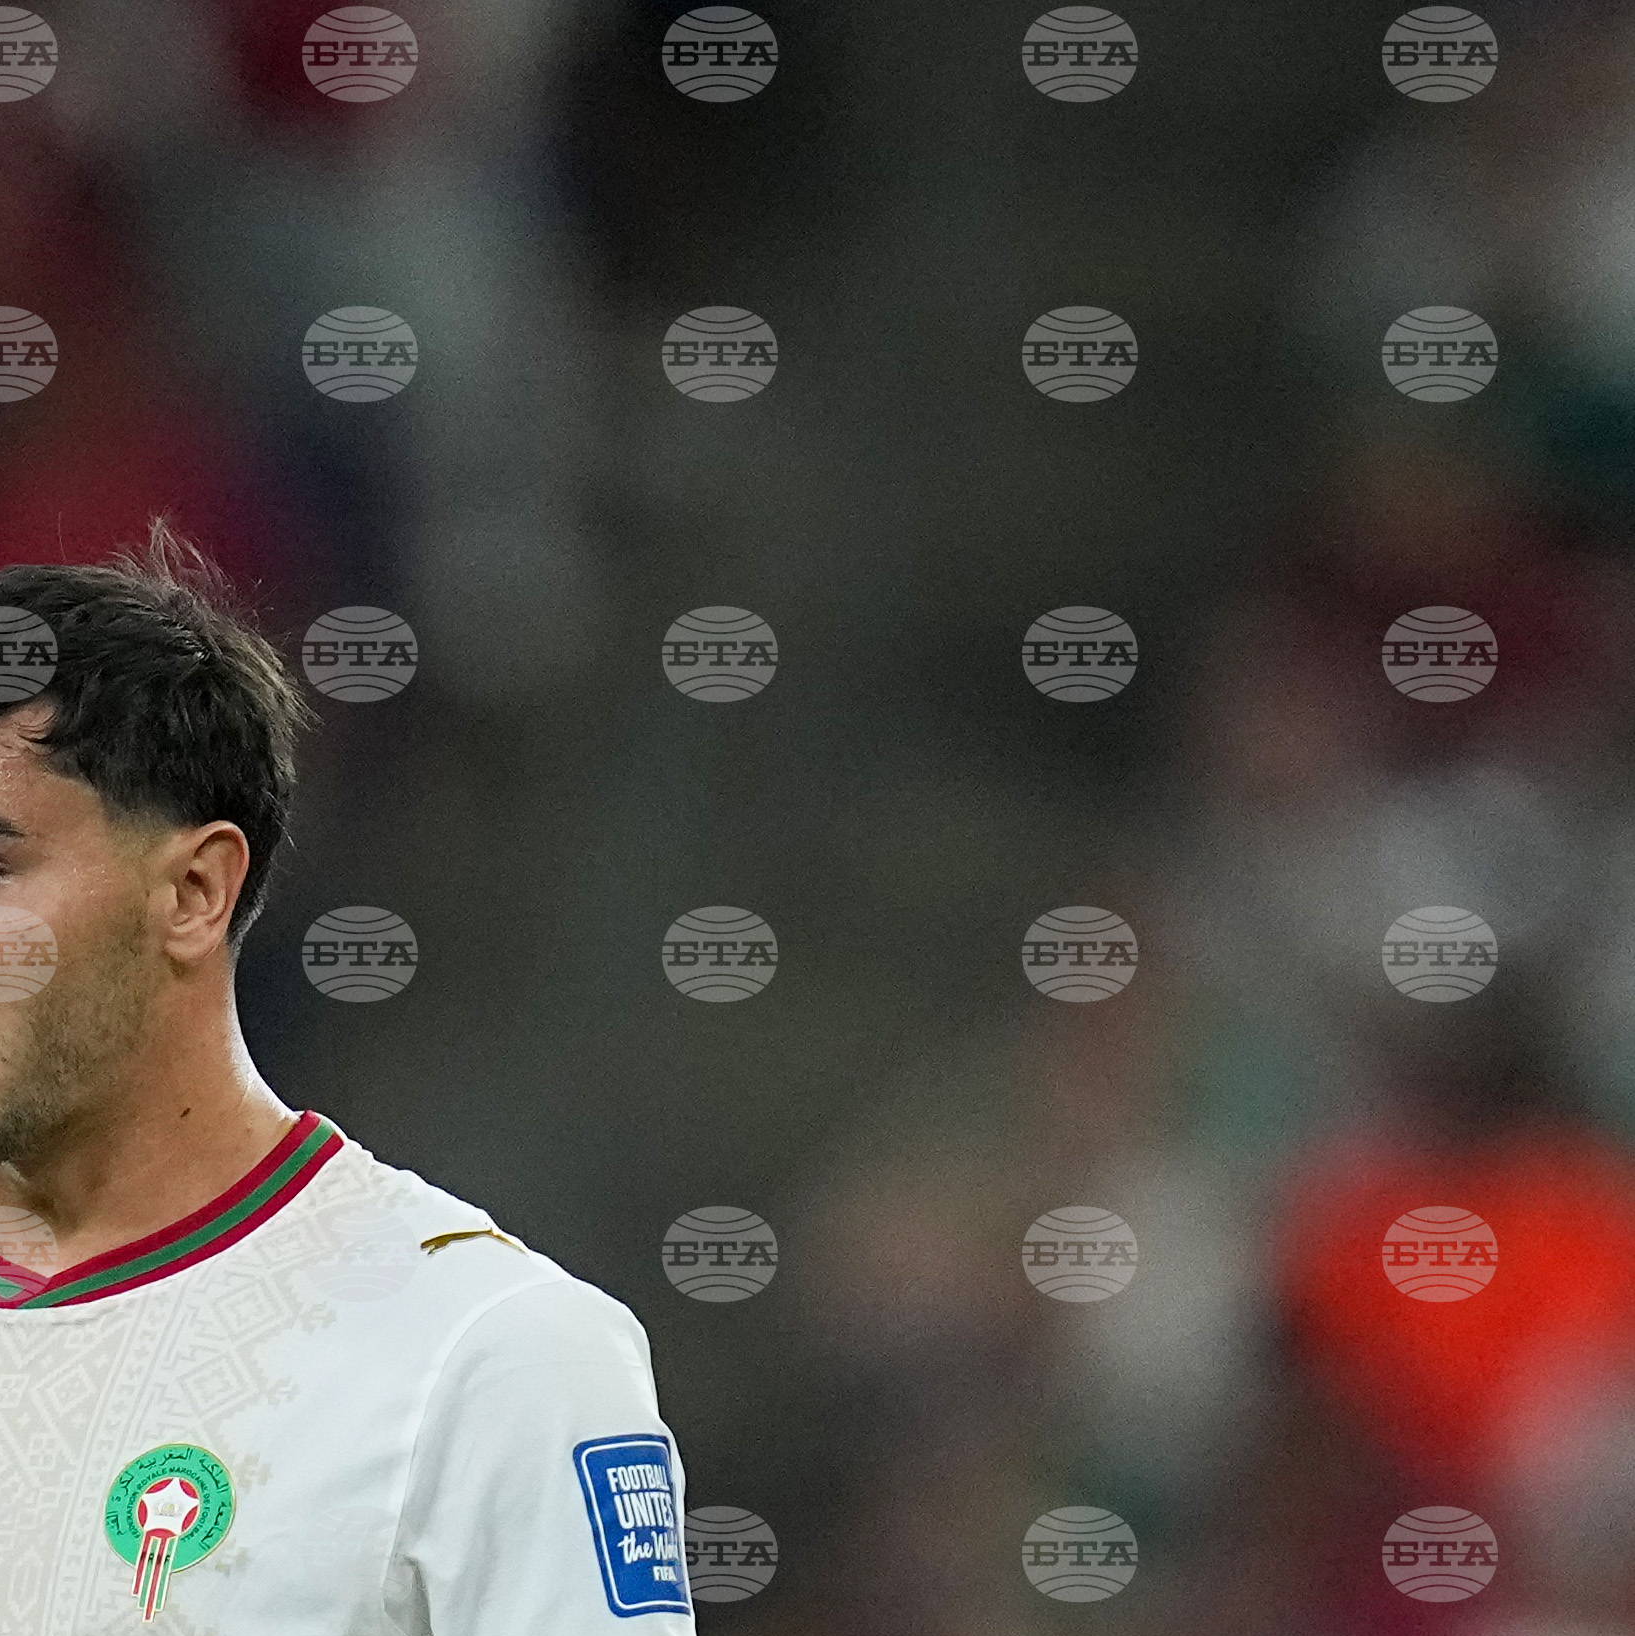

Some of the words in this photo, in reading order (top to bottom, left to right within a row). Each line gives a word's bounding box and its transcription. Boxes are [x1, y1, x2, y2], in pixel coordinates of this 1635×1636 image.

[606, 1464, 671, 1493] FOOTBALL
[613, 1491, 675, 1530] UNITES
[617, 1531, 653, 1565] the
[652, 1565, 677, 1582] FIFA
